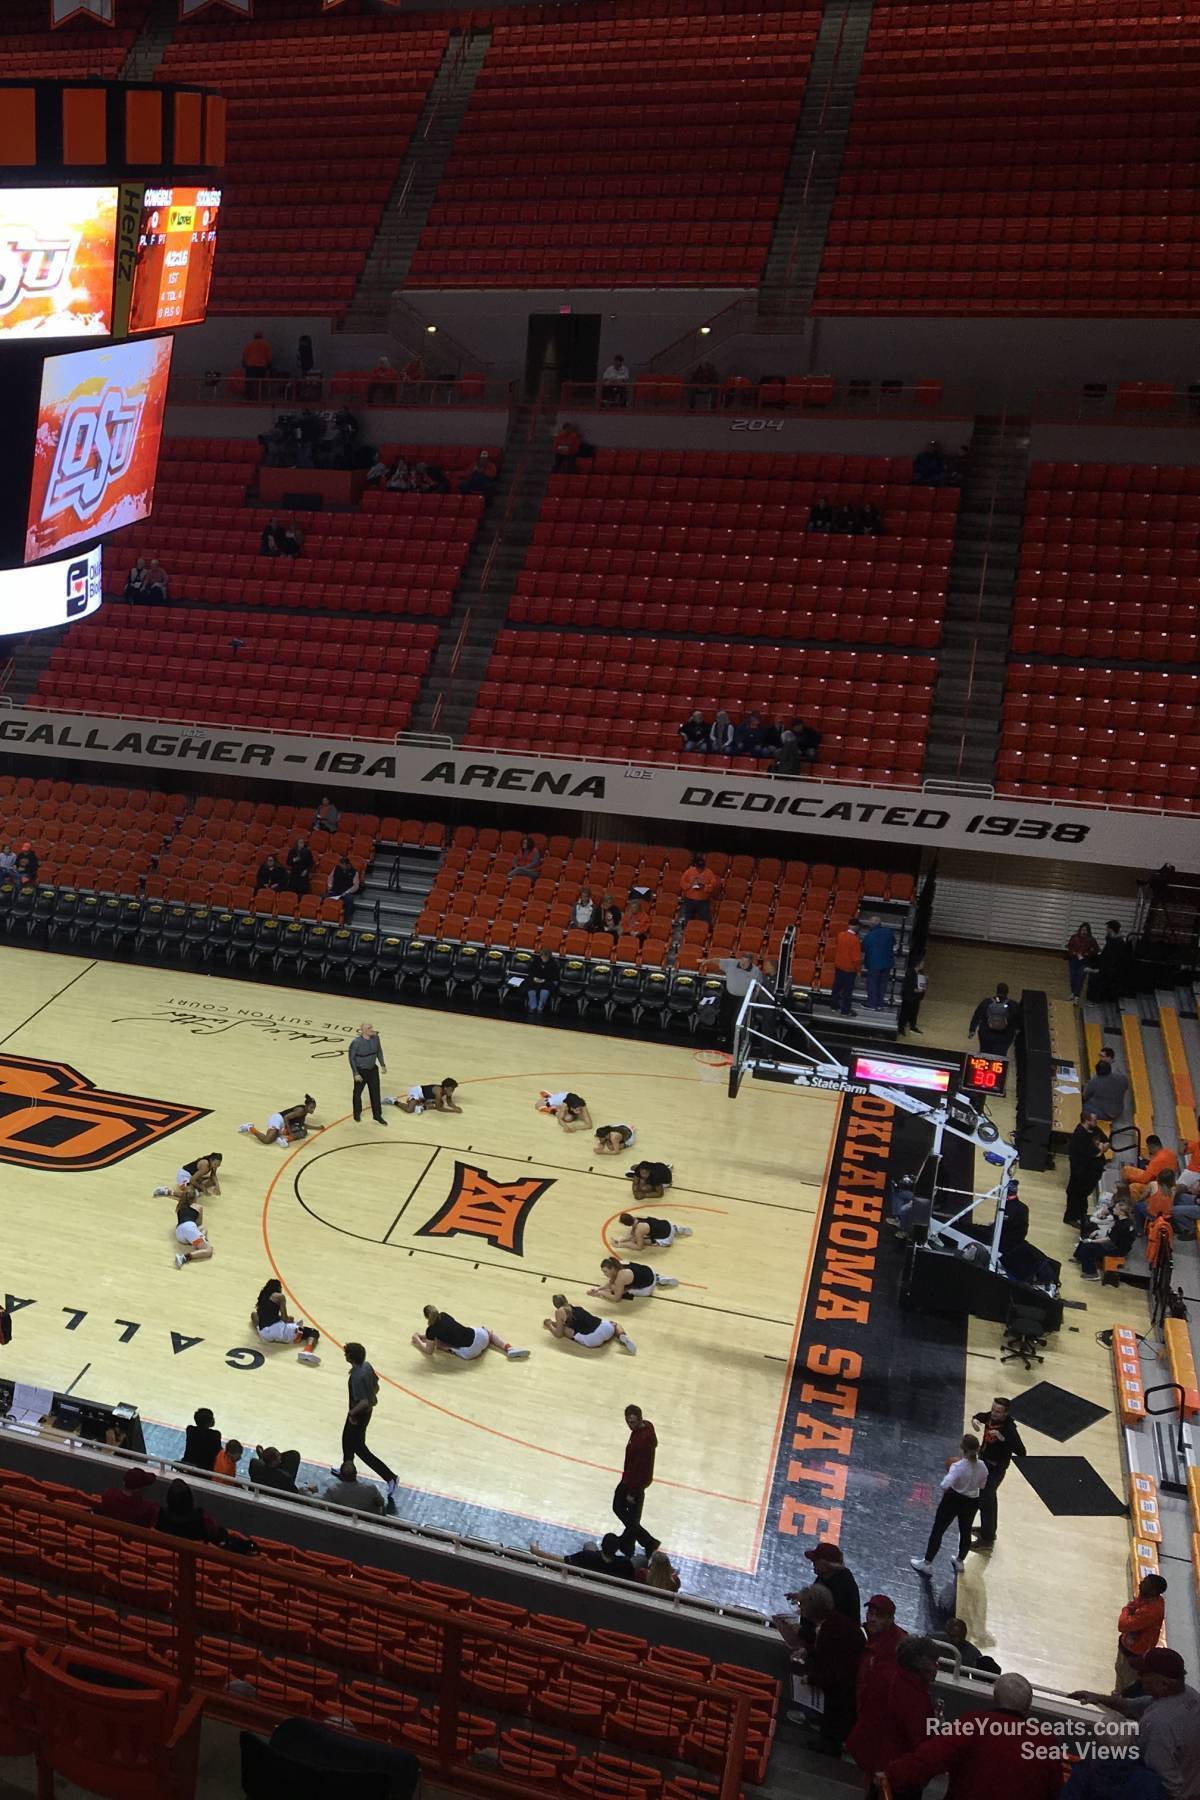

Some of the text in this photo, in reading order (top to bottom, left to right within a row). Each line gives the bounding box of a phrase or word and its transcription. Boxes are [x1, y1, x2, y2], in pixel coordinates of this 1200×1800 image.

[118, 189, 140, 282] Hertz
[730, 418, 785, 432] 204
[40, 385, 147, 522] OSU
[624, 767, 656, 780] 103
[420, 761, 606, 799] ARENA
[679, 786, 951, 831] DEDICATED
[965, 814, 1092, 845] 1938
[166, 998, 228, 1013] COURT
[238, 1008, 312, 1026] SUTTON
[970, 1058, 1003, 1073] 42:16
[973, 1071, 996, 1088] 30
[815, 1094, 896, 1325] OKLAHOMA
[778, 1344, 863, 1547] STATE
